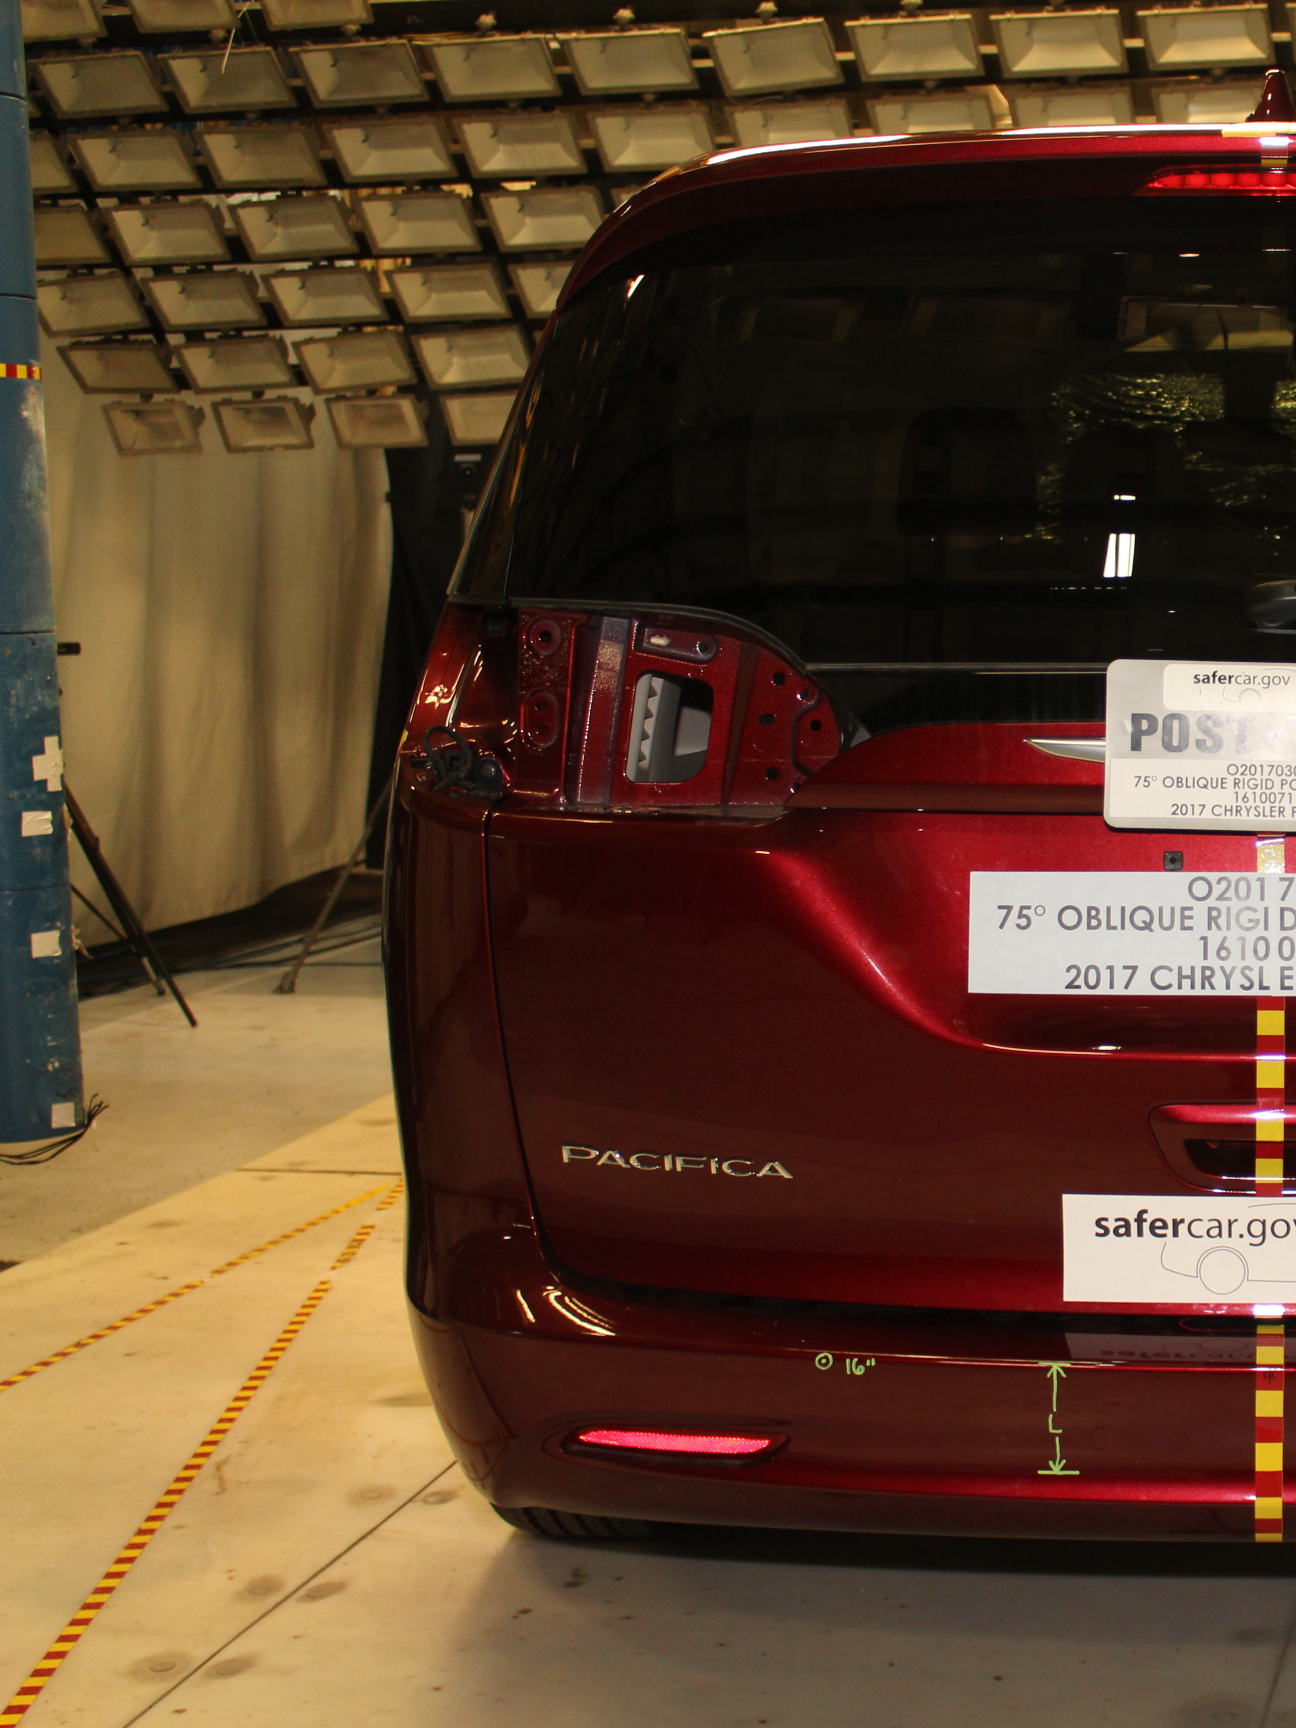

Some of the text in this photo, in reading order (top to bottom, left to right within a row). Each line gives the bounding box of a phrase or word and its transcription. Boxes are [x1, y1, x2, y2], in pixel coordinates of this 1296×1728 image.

[1193, 669, 1291, 688] safercar.gov
[1134, 775, 1158, 788] 75°
[1162, 776, 1228, 791] OBLIQUE
[1233, 778, 1275, 791] RIGID
[1170, 803, 1206, 817] 2017
[1211, 804, 1286, 819] CHRYSLER
[997, 904, 1046, 931] 75°
[1057, 905, 1195, 934] OBLIQUE
[1064, 964, 1139, 992] 2017
[561, 1144, 794, 1180] PACIFICA
